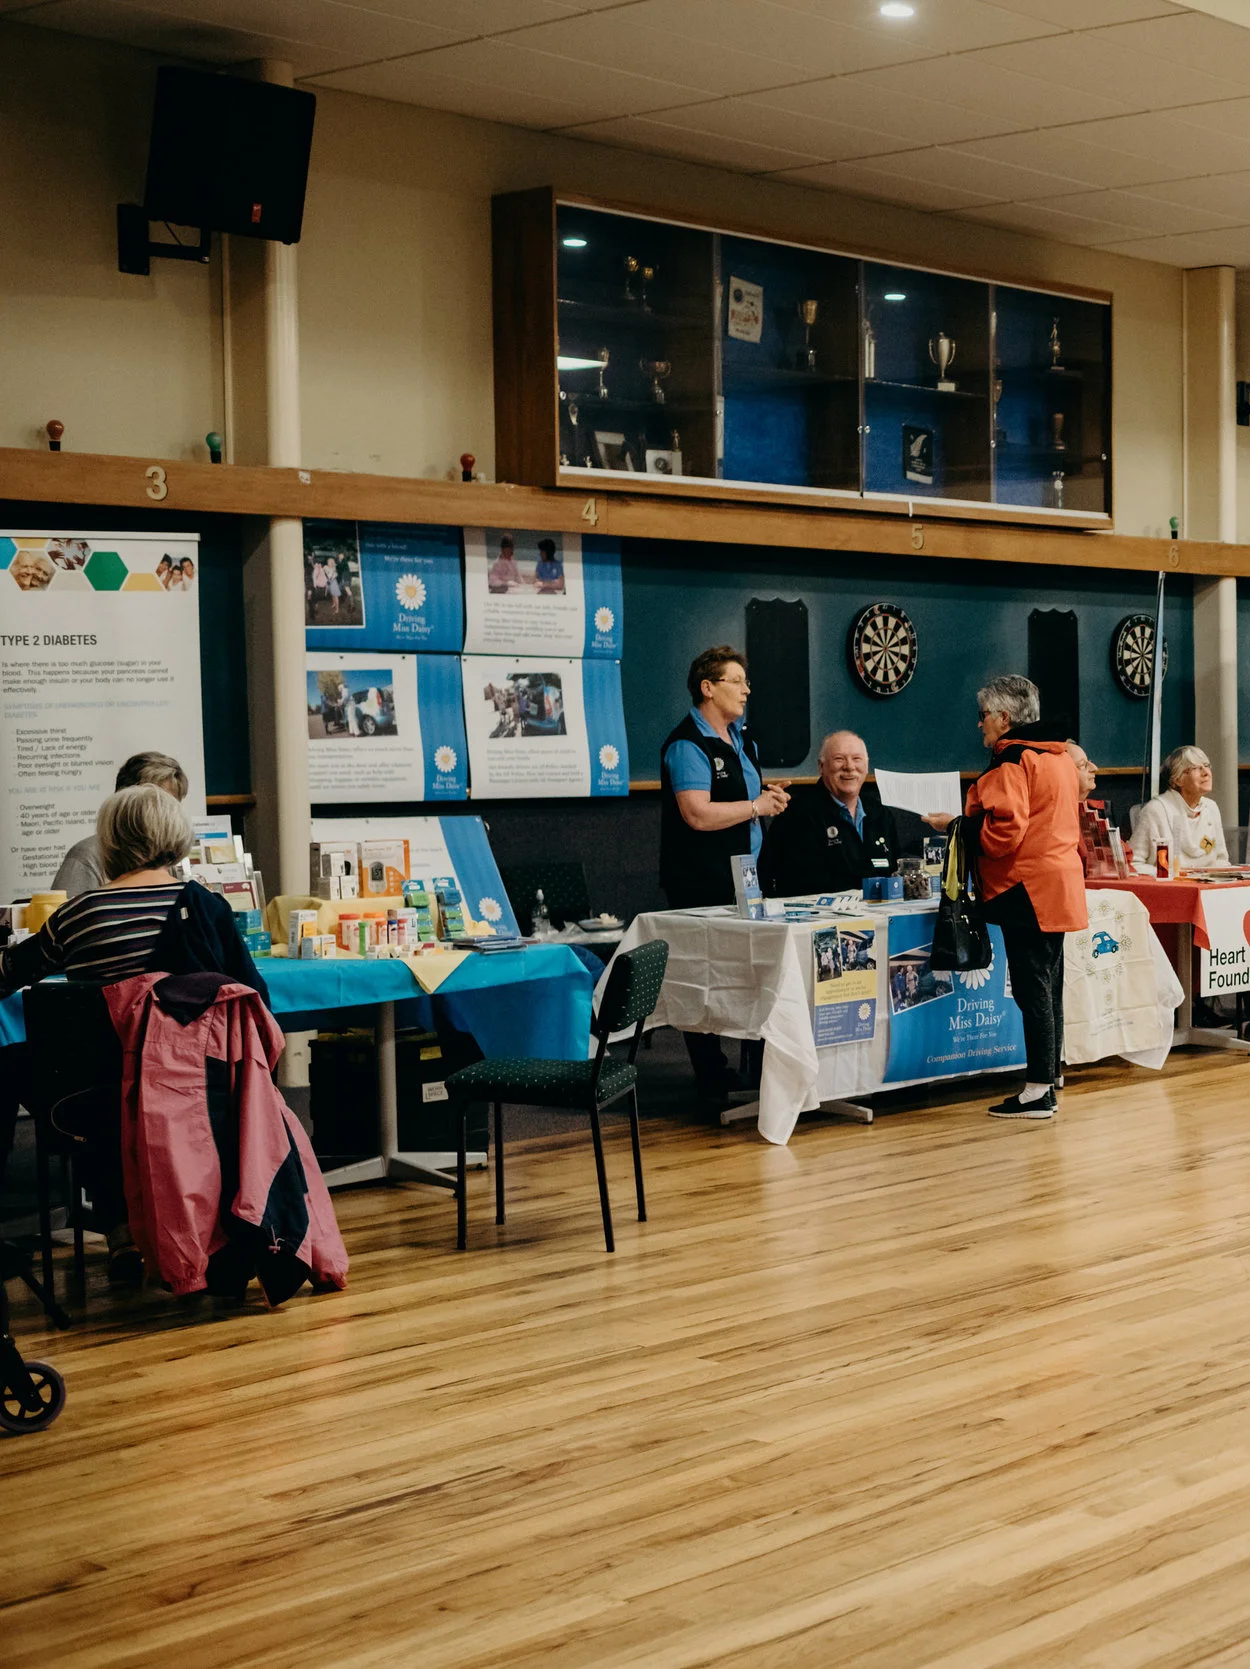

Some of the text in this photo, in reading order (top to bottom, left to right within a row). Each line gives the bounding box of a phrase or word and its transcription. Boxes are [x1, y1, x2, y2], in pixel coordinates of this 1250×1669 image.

[145, 466, 167, 501] 3
[582, 498, 599, 526] 4
[911, 523, 924, 549] 5
[1169, 544, 1179, 568] 6
[399, 613, 426, 626] Driving
[393, 622, 431, 635] Miss Daisy
[0, 634, 97, 646] TYPE 2 DIABETES
[43, 669, 69, 677] happens
[23, 677, 47, 685] enough
[95, 676, 111, 684] body
[61, 735, 93, 743] frequently
[65, 744, 87, 752] energy
[61, 769, 82, 777] hungry
[22, 853, 59, 861] Gestational
[1210, 946, 1245, 966] Heart
[957, 998, 995, 1013] Driving
[948, 1012, 1002, 1031] Miss Daisy
[980, 1032, 988, 1040] For
[926, 1044, 1017, 1064] Companion Driving Service
